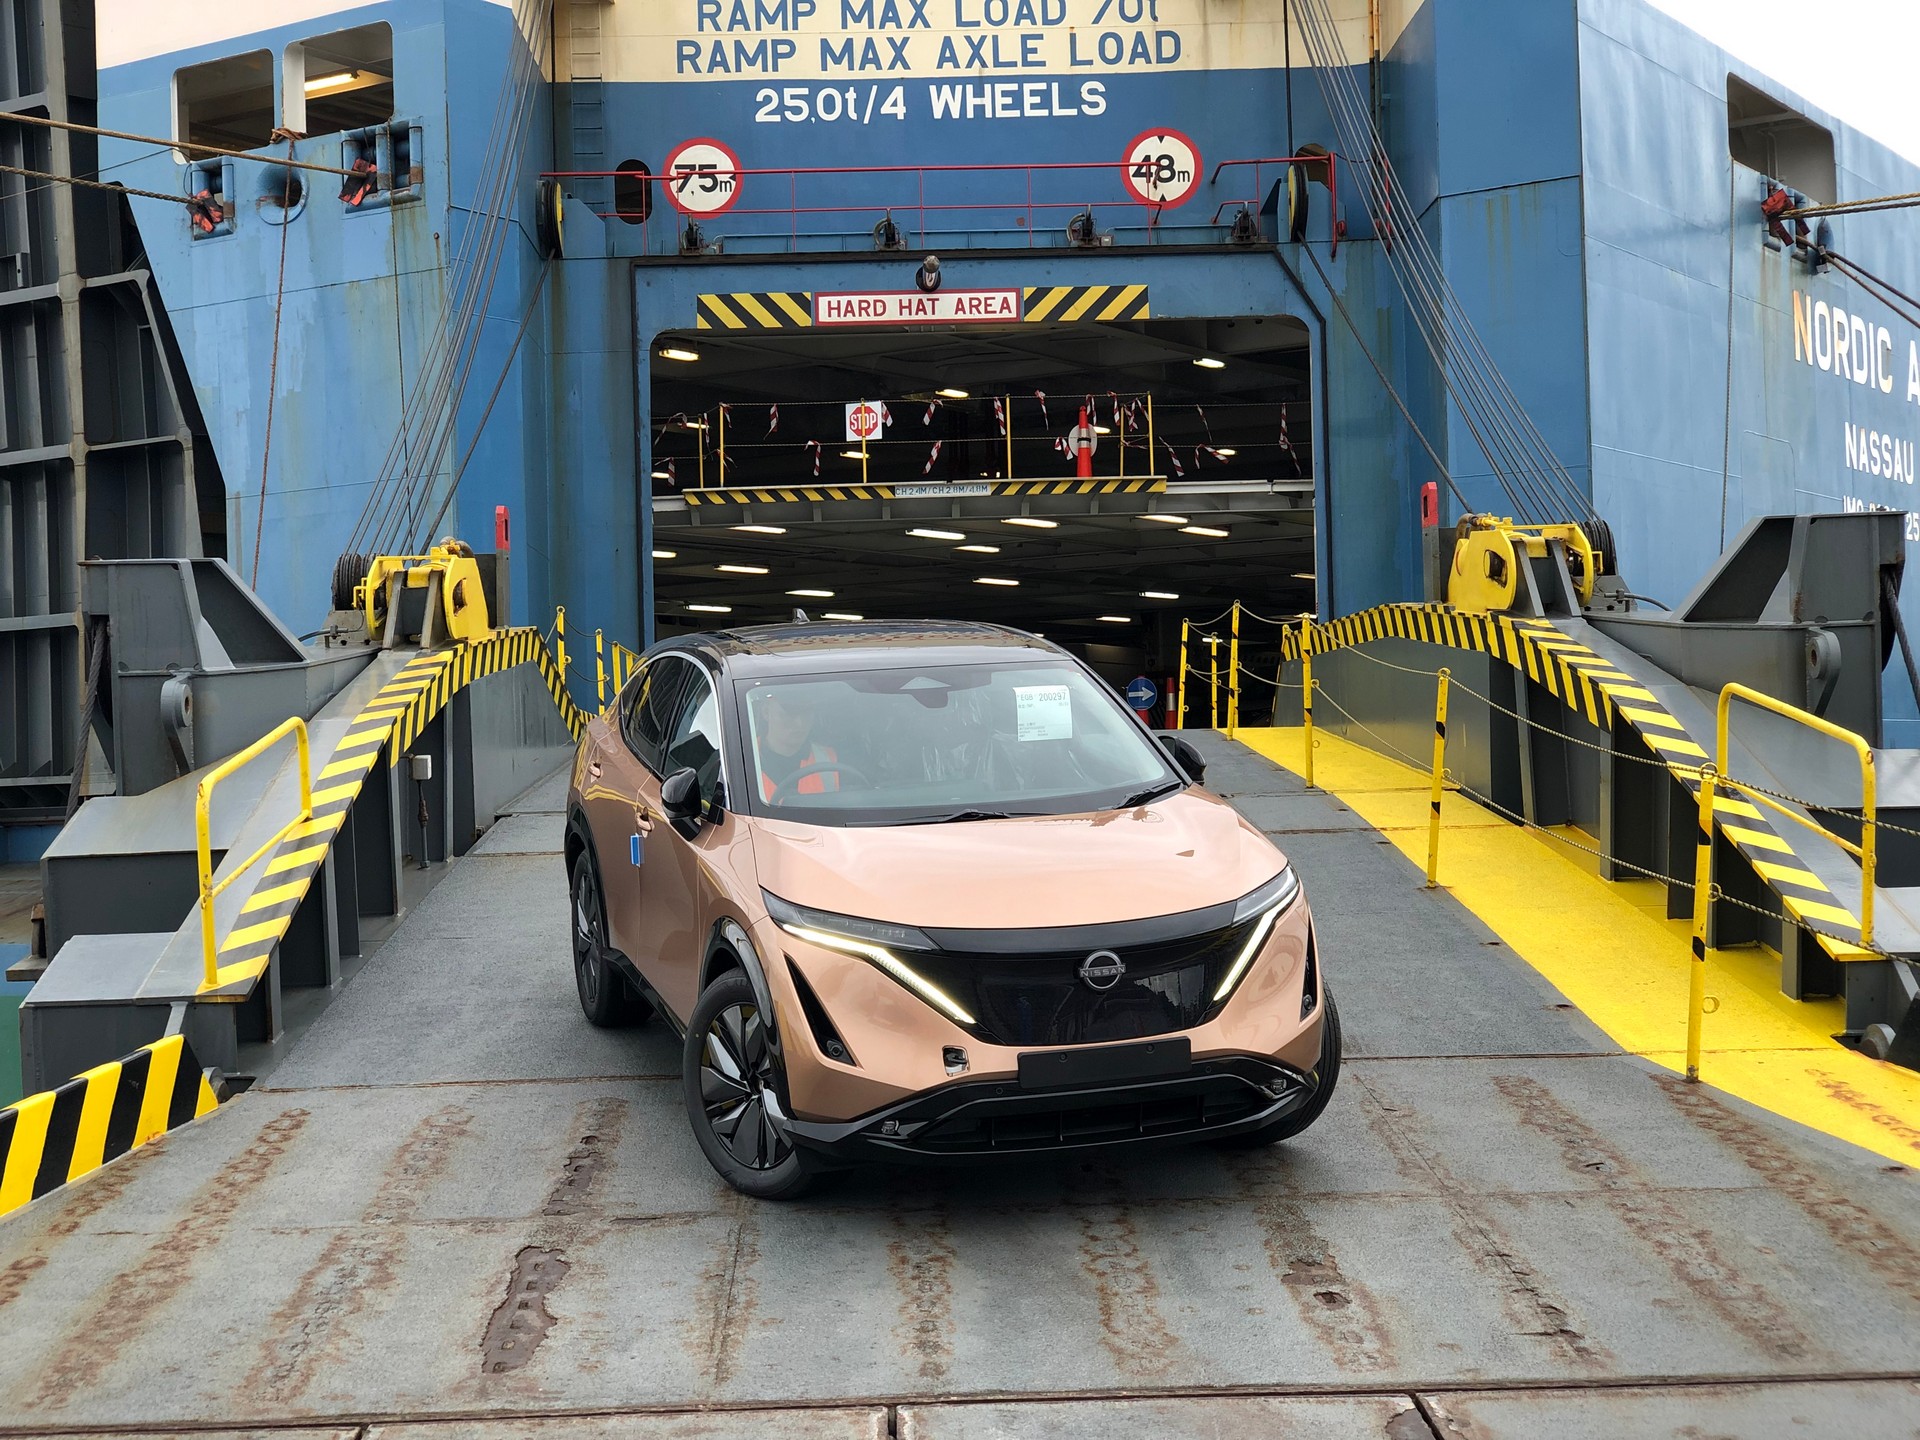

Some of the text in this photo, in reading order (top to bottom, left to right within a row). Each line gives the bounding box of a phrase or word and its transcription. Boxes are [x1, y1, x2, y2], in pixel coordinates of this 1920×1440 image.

[697, 0, 817, 32] RAMP
[841, 0, 931, 30] MAX
[955, 0, 1067, 27] LOAD
[676, 30, 1182, 74] RAMP MAX AXLE LOAD
[929, 81, 1107, 120] WHEELS
[827, 296, 1013, 318] HARD HAT AREA
[1792, 289, 1894, 394] NORDIC
[850, 412, 877, 430] STOP
[1844, 421, 1915, 485] NASSAU
[1038, 691, 1066, 702] 200297
[1080, 966, 1126, 978] NISSAN
